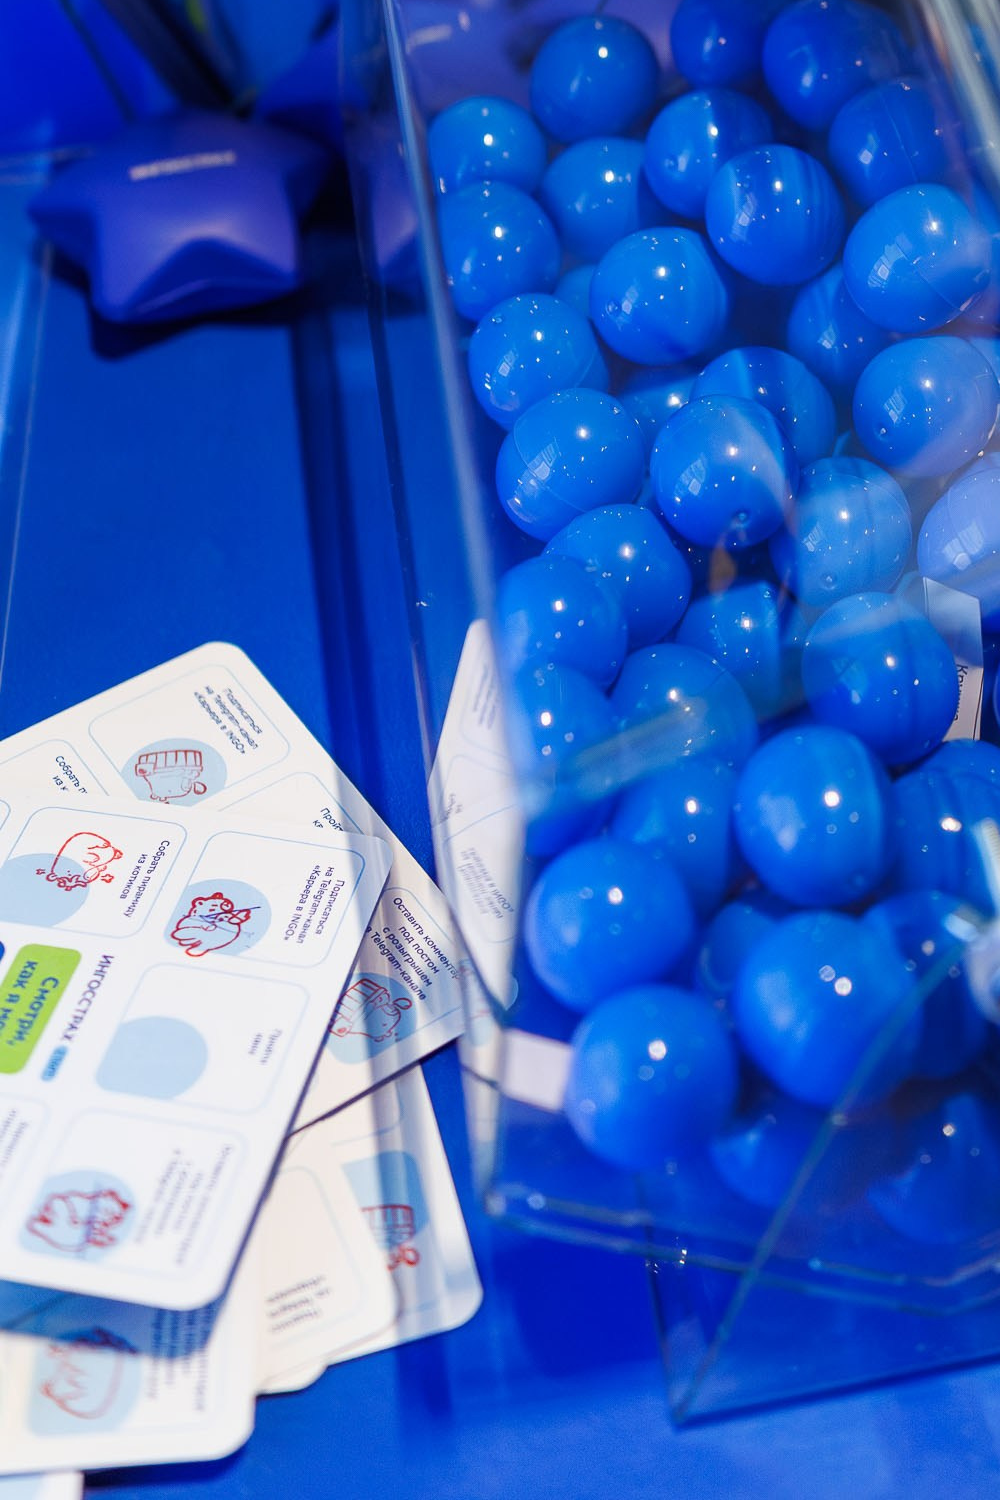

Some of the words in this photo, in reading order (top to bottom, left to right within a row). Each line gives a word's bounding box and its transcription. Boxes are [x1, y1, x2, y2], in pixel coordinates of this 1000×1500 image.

[56, 756, 80, 787] Собрать
[138, 854, 148, 864] из
[147, 840, 170, 874] Собрать
[325, 867, 334, 877] на
[120, 866, 141, 899] котиков
[124, 876, 151, 917] пирамиду
[299, 865, 321, 904] «Карьера
[296, 880, 331, 943] Telegram-канал
[315, 879, 345, 934] Подписаться
[393, 897, 424, 936] Оставить
[284, 913, 302, 940] INGO»
[371, 932, 426, 1000] Telegram-канале
[387, 933, 432, 987] розыгрышем
[399, 926, 414, 944] под
[412, 943, 440, 974] постом
